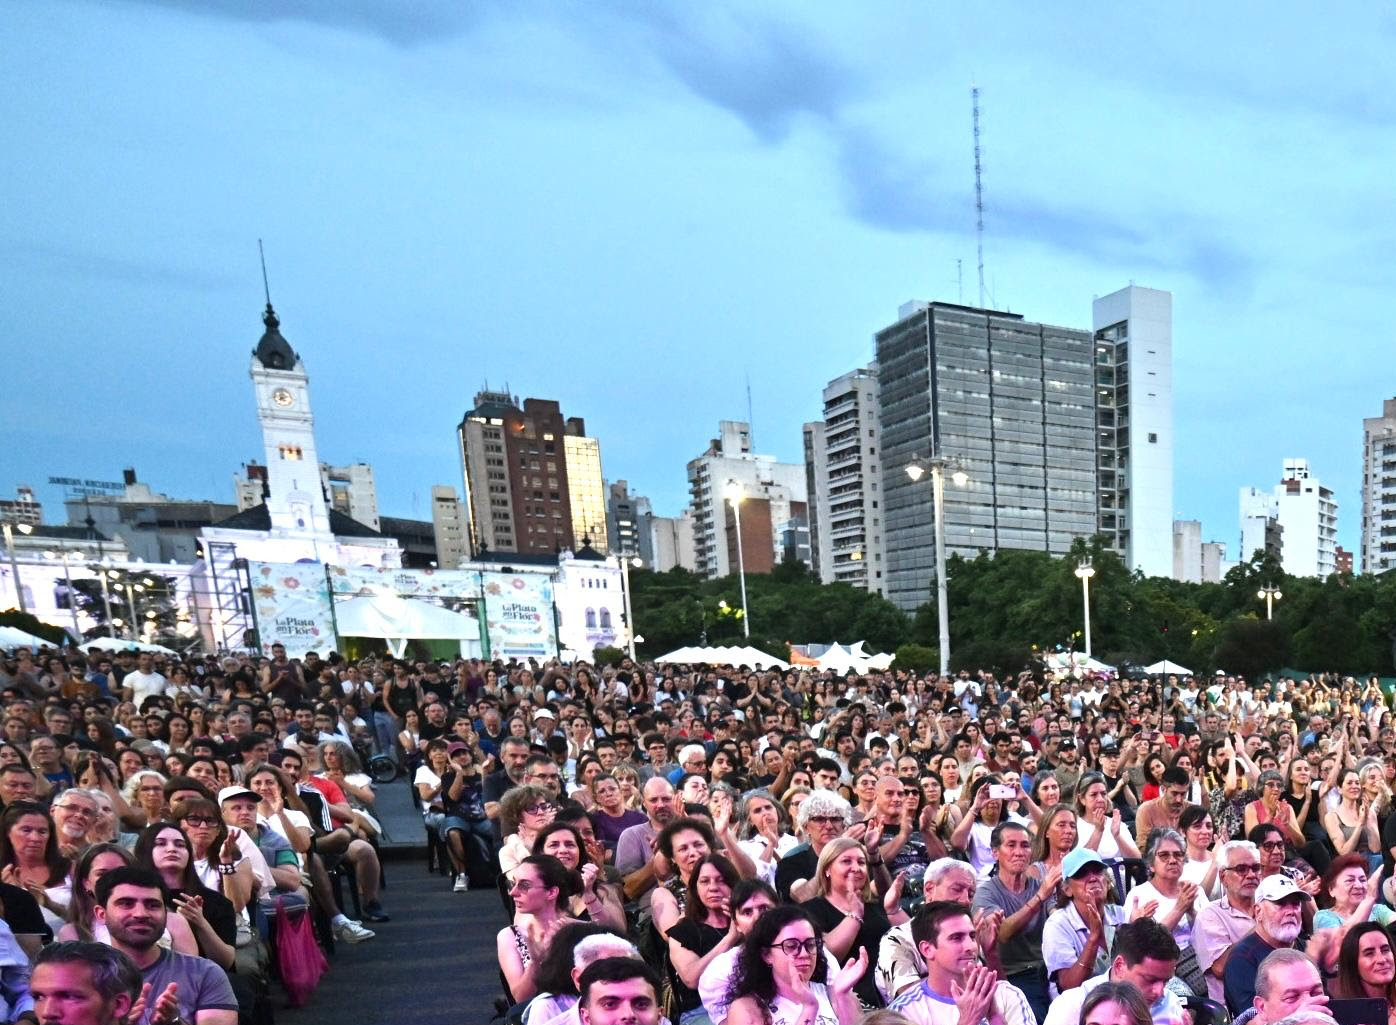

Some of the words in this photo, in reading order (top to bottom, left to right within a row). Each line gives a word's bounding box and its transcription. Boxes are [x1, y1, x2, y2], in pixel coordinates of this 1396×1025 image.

[511, 603, 537, 612] Plata
[513, 611, 533, 620] Flor
[286, 616, 315, 626] Plata
[287, 626, 311, 635] Flor
